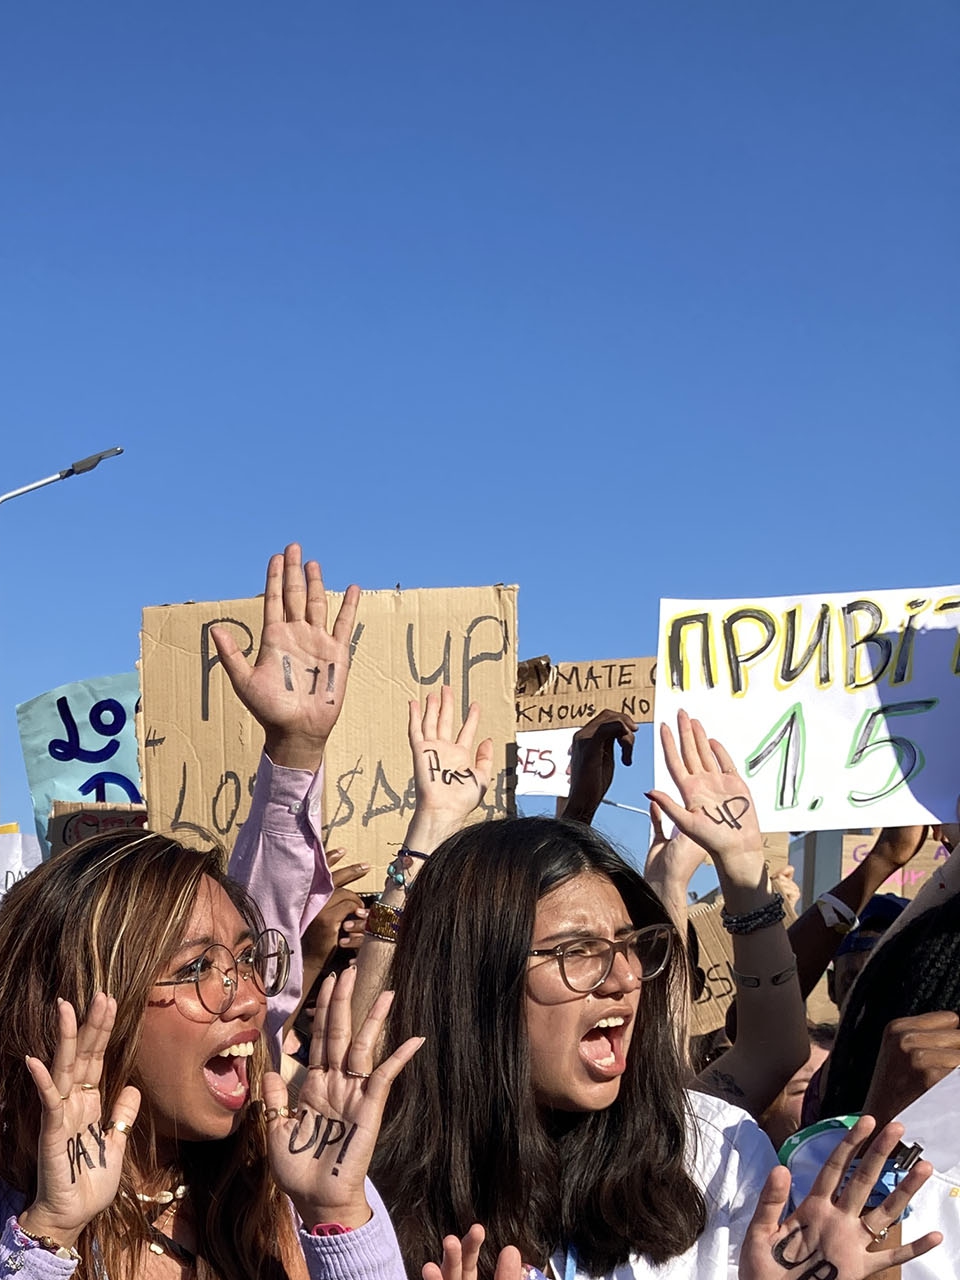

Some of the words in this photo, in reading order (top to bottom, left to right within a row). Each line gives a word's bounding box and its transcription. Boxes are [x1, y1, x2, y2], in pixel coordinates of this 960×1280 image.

[407, 615, 511, 725] UP
[48, 696, 141, 763] LO
[745, 700, 938, 811] 1.5
[423, 749, 478, 788] Pay
[701, 796, 750, 830] UP
[66, 1121, 113, 1184] PAY
[288, 1109, 357, 1177] UP!
